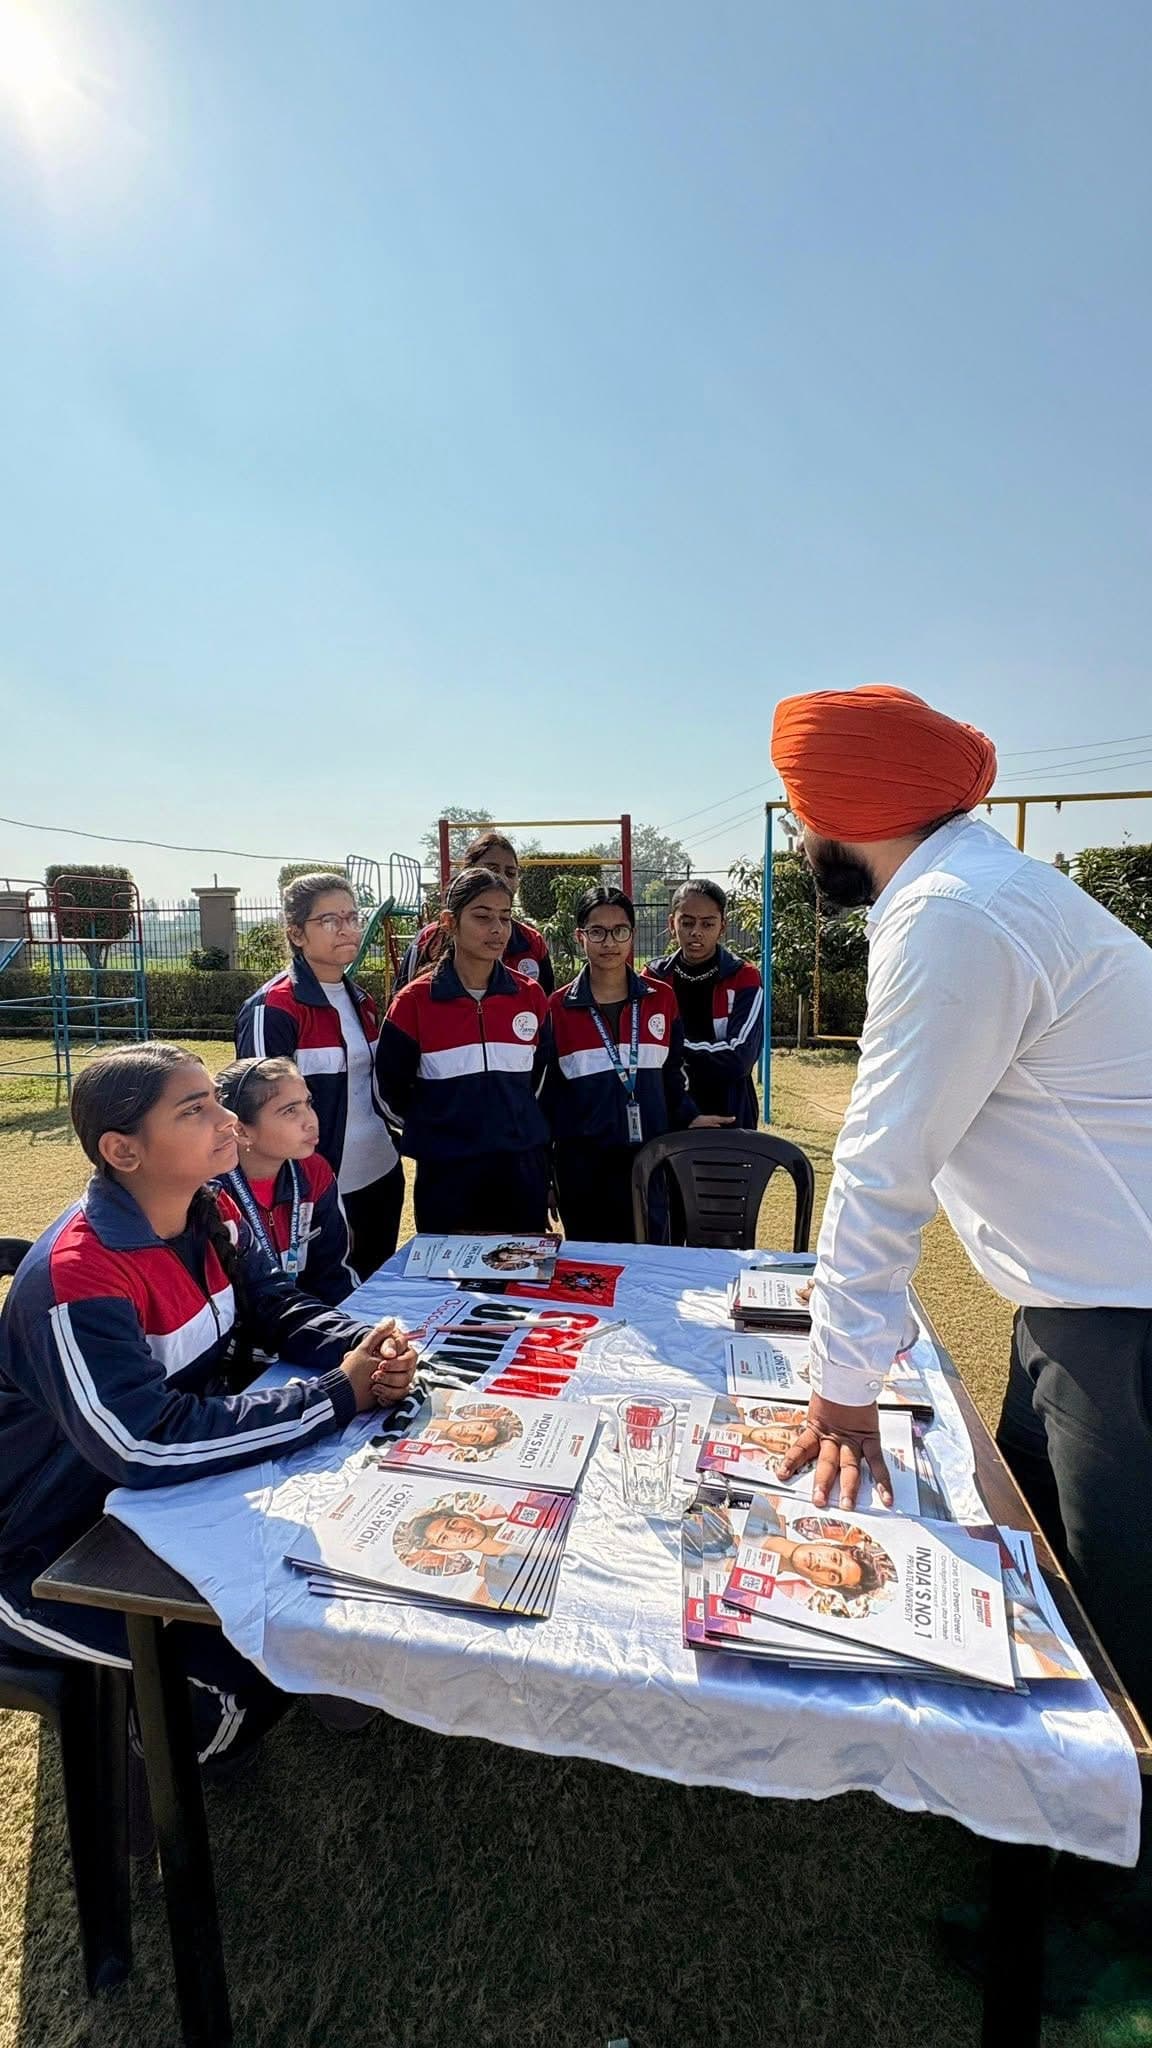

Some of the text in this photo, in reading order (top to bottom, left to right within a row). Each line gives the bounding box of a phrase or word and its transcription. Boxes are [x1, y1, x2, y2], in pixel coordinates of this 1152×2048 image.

[246, 1204, 265, 1237] ACADEMY
[483, 1310, 600, 1399] CHAN
[531, 1413, 553, 1447] INDIA'S
[351, 1508, 392, 1552] INDIA'S
[904, 1554, 914, 1623] PRIVATE UNIVERSITY
[916, 1546, 931, 1600] INDIA'S
